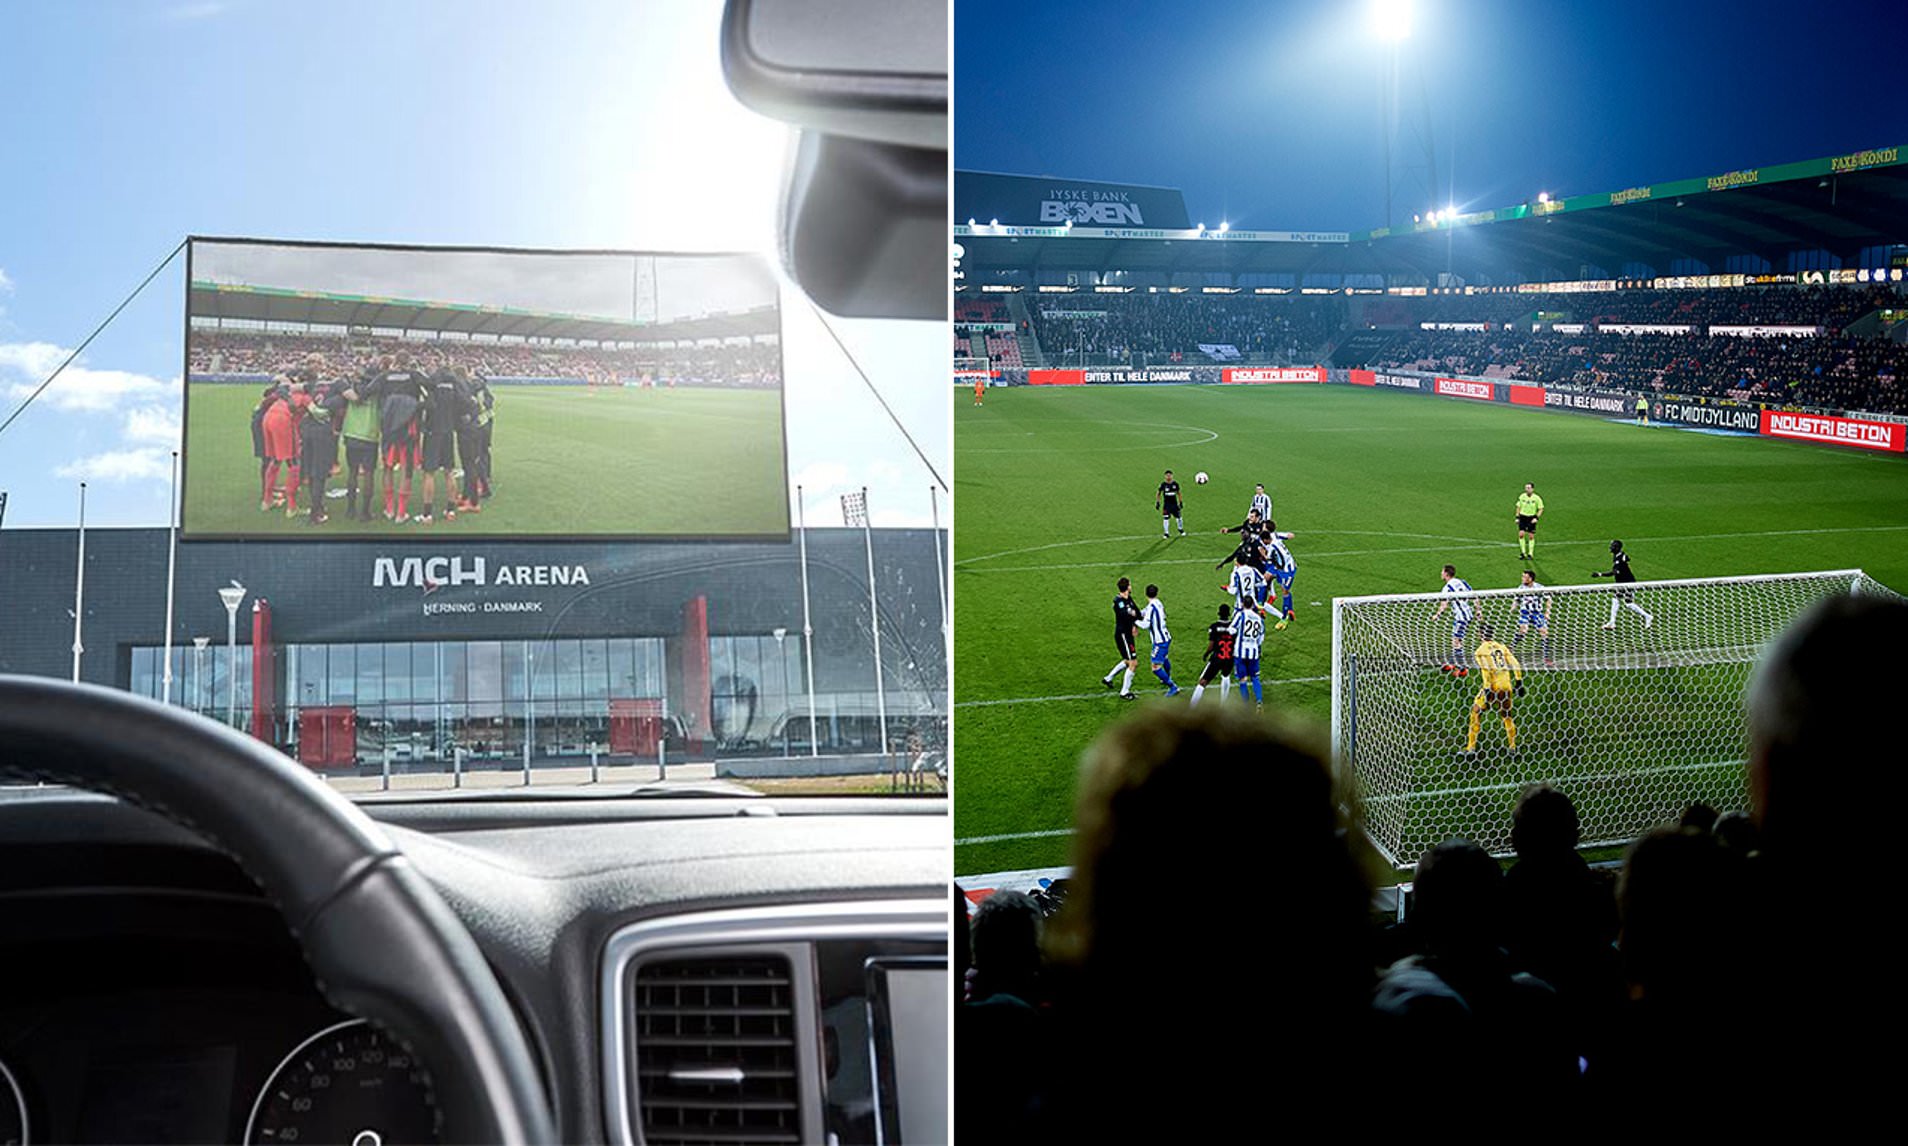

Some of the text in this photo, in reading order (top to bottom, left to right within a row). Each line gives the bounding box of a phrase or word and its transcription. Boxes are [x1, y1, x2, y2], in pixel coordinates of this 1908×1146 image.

[1858, 148, 1898, 166] KONDI
[1050, 189, 1129, 202] JYSKE BANK
[1085, 370, 1191, 383] ENTER TIL HELE DANMARK
[1544, 391, 1624, 412] ENTER TIL HELE DANMARK
[1664, 404, 1758, 429] FC MIDTJYLLAND
[1770, 414, 1835, 436] INDUSTRI
[1836, 421, 1892, 443] BETON
[372, 556, 590, 586] MCH ARENA
[1244, 576, 1252, 591] 2
[423, 601, 543, 614] HERNING DANMARK
[1244, 619, 1260, 638] 28
[332, 1057, 356, 1071] 100
[292, 1097, 312, 1112] 60
[279, 1127, 299, 1141] 40
